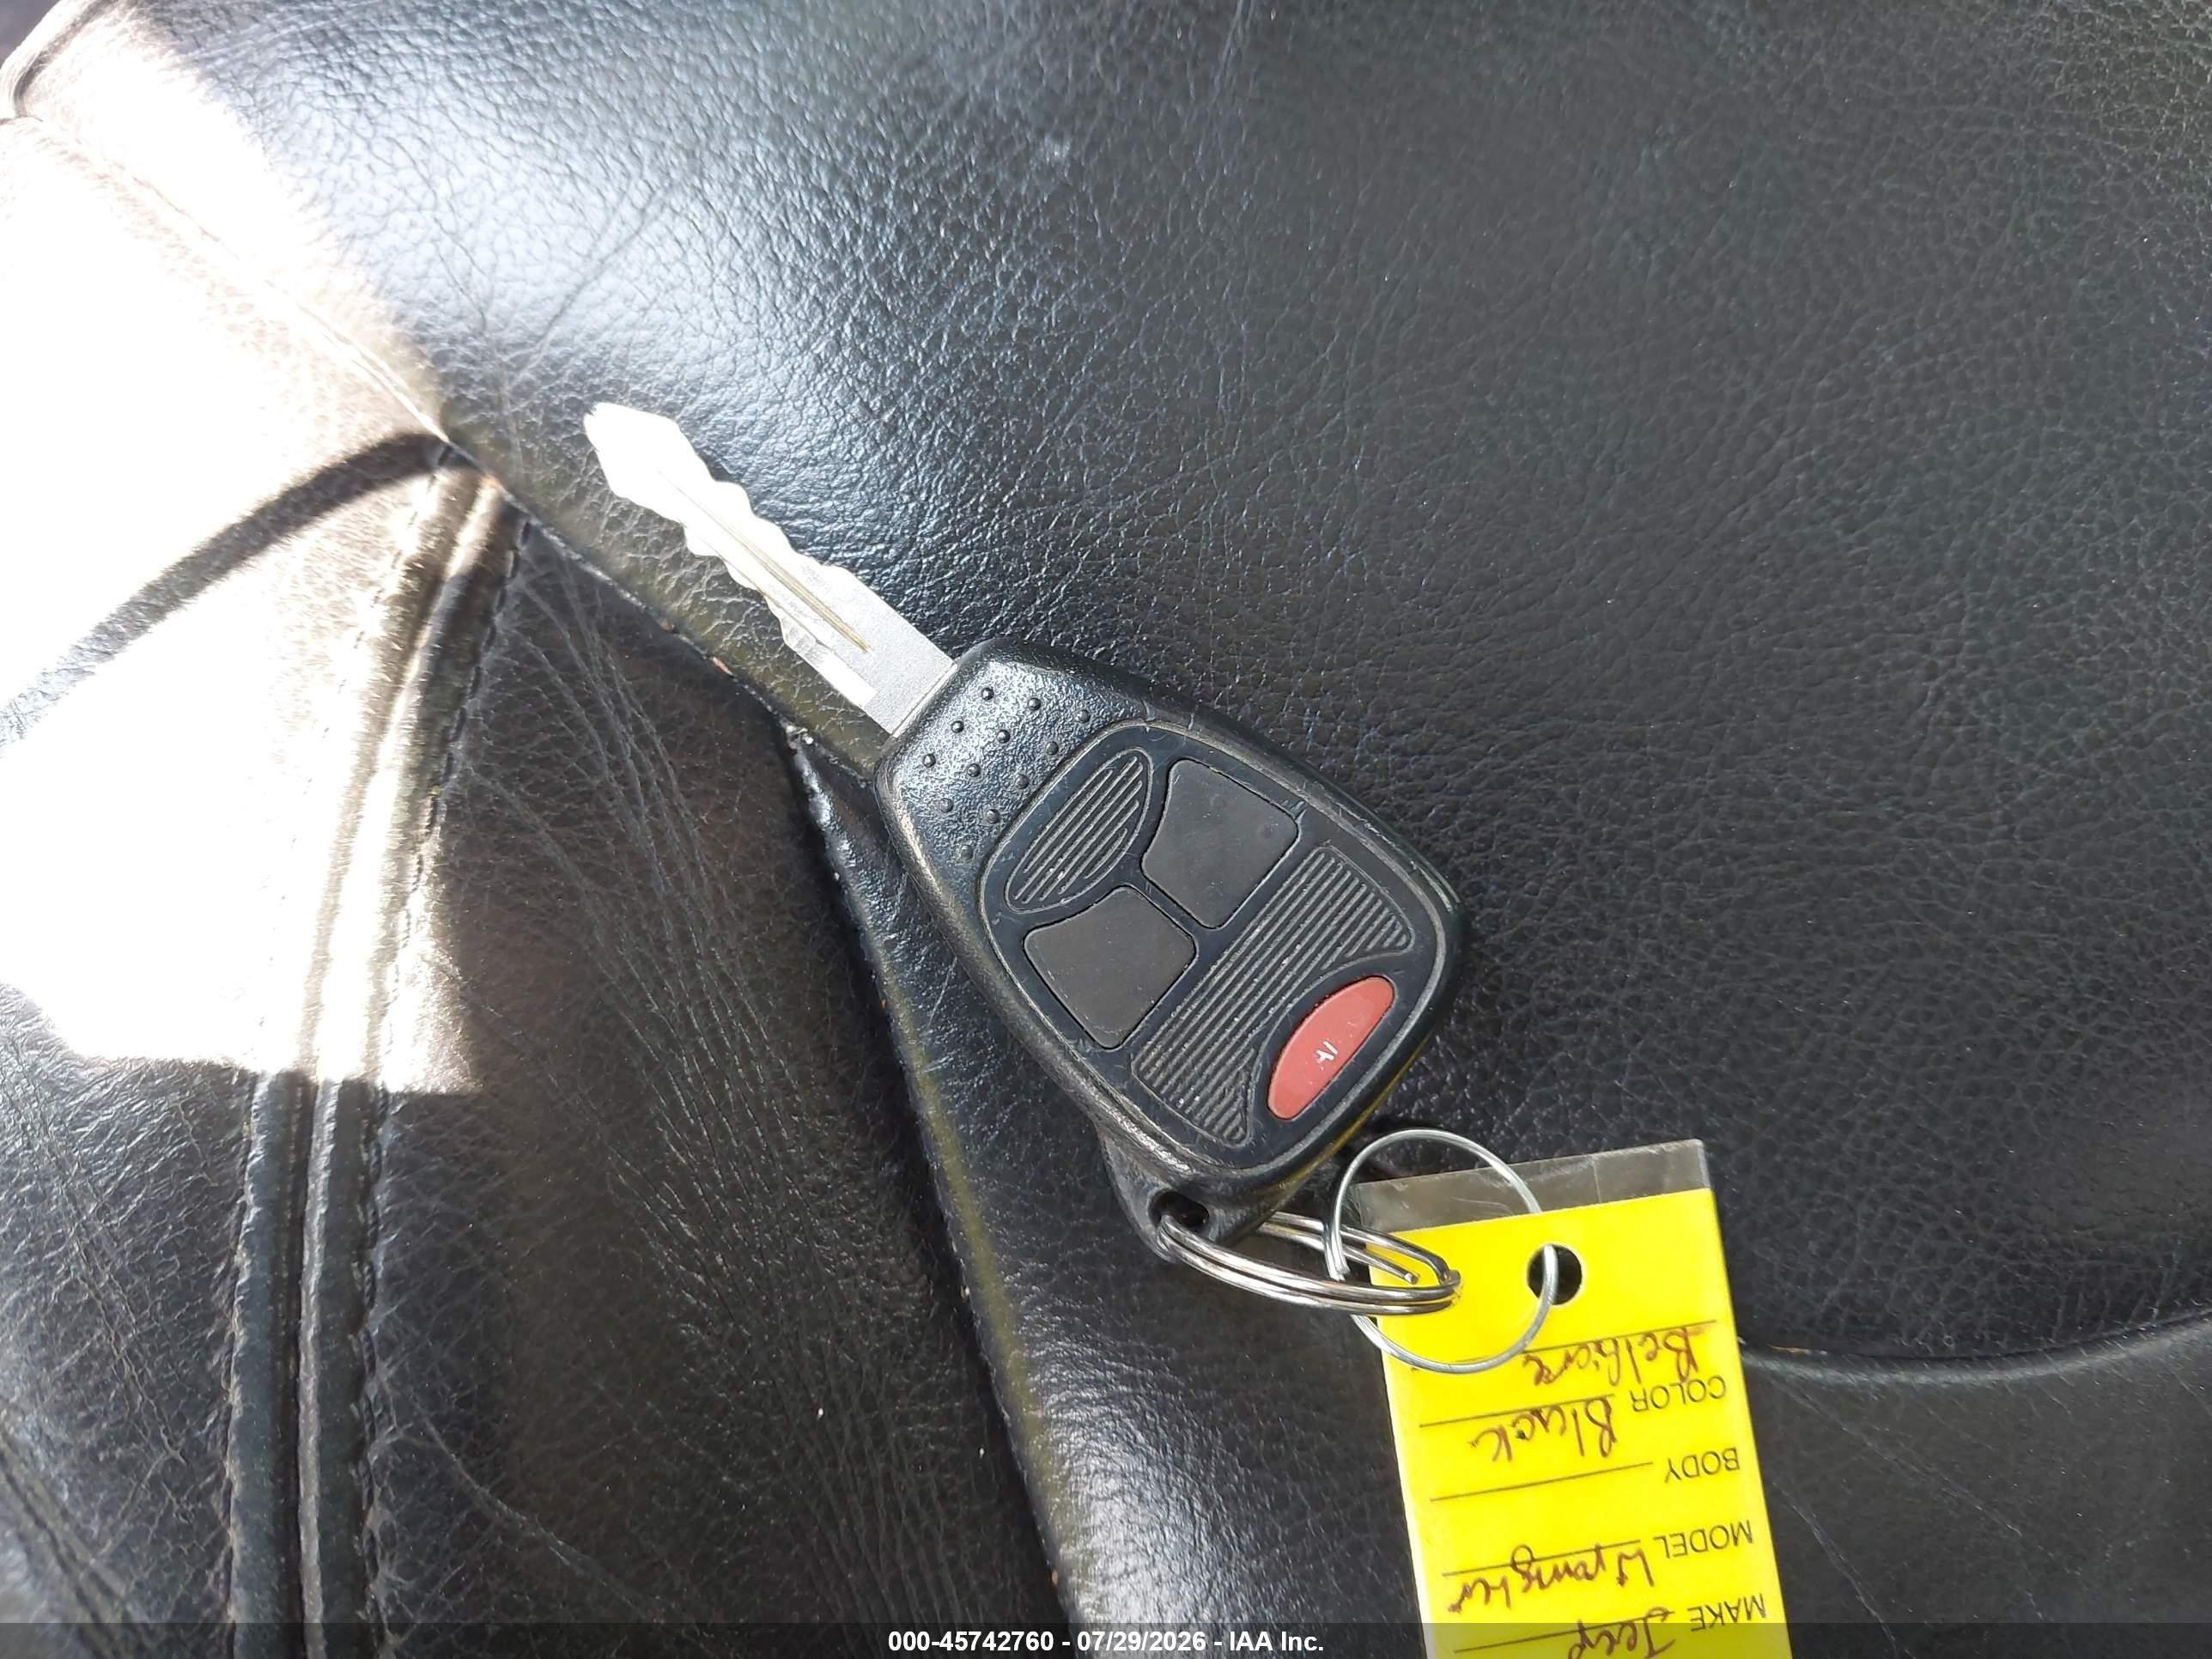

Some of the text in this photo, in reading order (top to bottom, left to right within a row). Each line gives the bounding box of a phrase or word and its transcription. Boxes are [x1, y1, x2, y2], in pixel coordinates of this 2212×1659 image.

[1630, 1376, 1726, 1413] COLOR
[1468, 1396, 1617, 1462] Black
[1664, 1447, 1741, 1483] BODY
[1654, 1519, 1753, 1559] MODEL
[1688, 1594, 1765, 1632] MAKE
